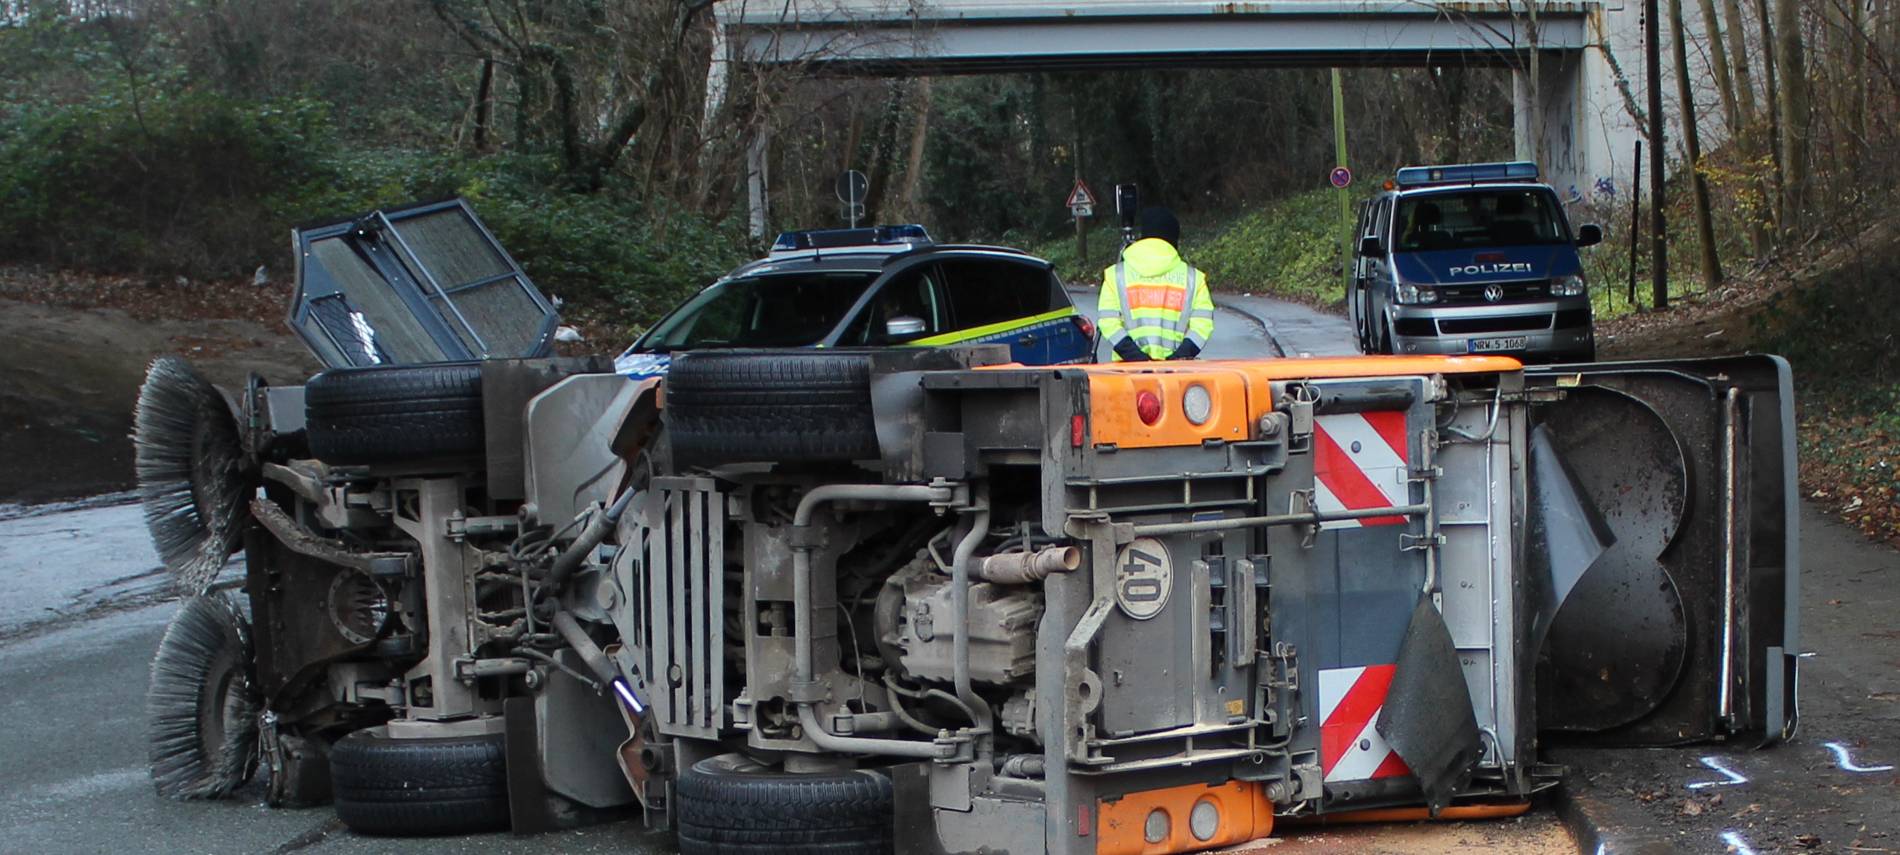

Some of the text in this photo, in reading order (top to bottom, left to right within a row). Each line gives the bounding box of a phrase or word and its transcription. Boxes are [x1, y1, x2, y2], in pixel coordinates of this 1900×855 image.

[1449, 262, 1532, 277] POLIZEI
[1474, 339, 1491, 350] NRW
[1122, 548, 1162, 602] 40
